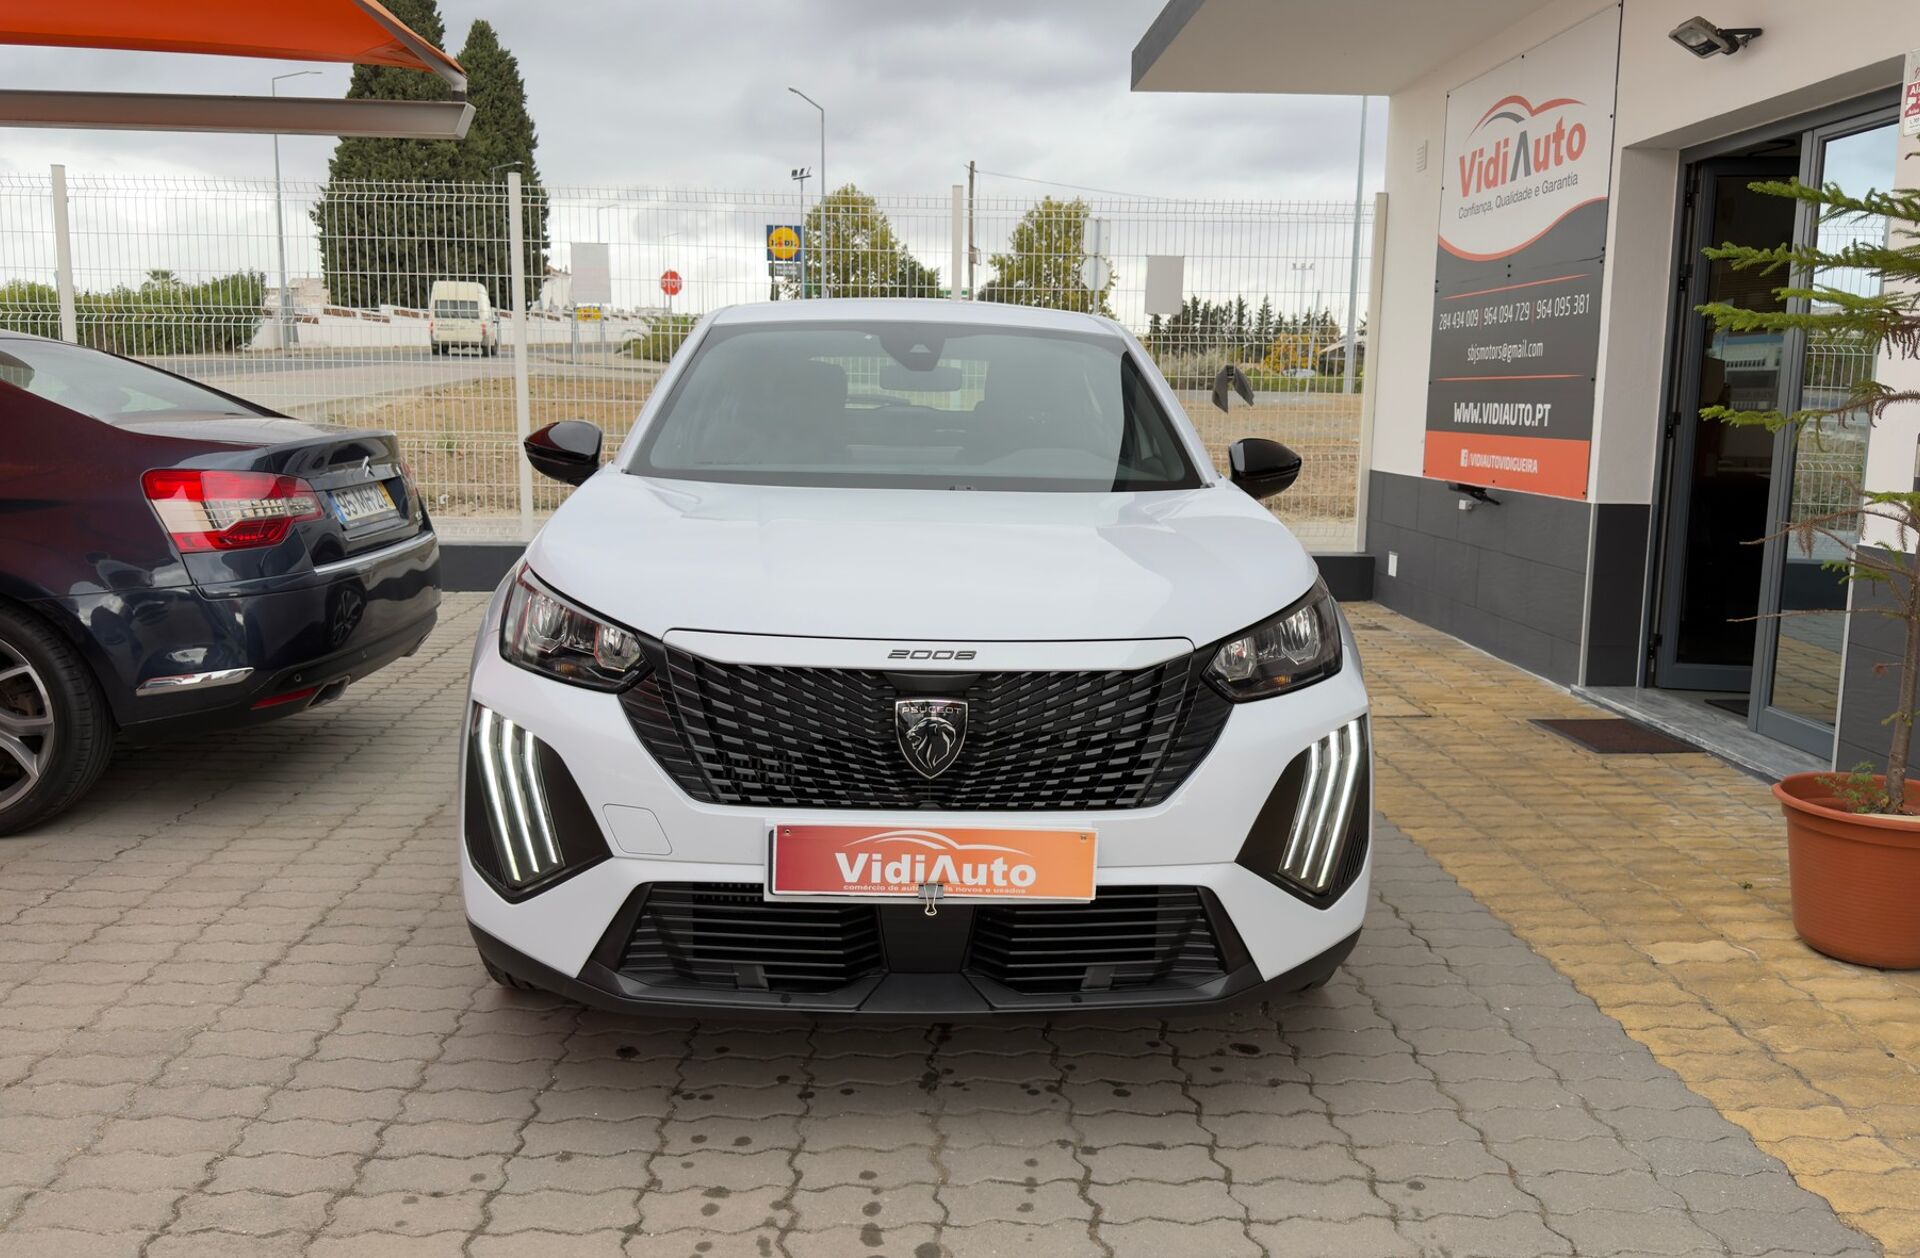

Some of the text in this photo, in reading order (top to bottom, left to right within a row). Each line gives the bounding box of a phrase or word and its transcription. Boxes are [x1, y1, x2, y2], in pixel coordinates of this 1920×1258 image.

[1459, 116, 1586, 198] VidiAuto
[1458, 171, 1578, 219] Confiança, Qualidade e Garantia
[661, 279, 682, 288] STOP
[1439, 293, 1590, 330] 284 434 009 964 094 729 964 095 381
[1467, 340, 1544, 364] sbjsmotors@gmail.com
[1454, 402, 1551, 427] WWW.VIDIAUTO.PT
[888, 649, 977, 661] 2008
[902, 706, 962, 714] PEUGEOT
[834, 852, 1037, 887] VidiAuto
[843, 884, 886, 892] comércio
[888, 884, 899, 892] de
